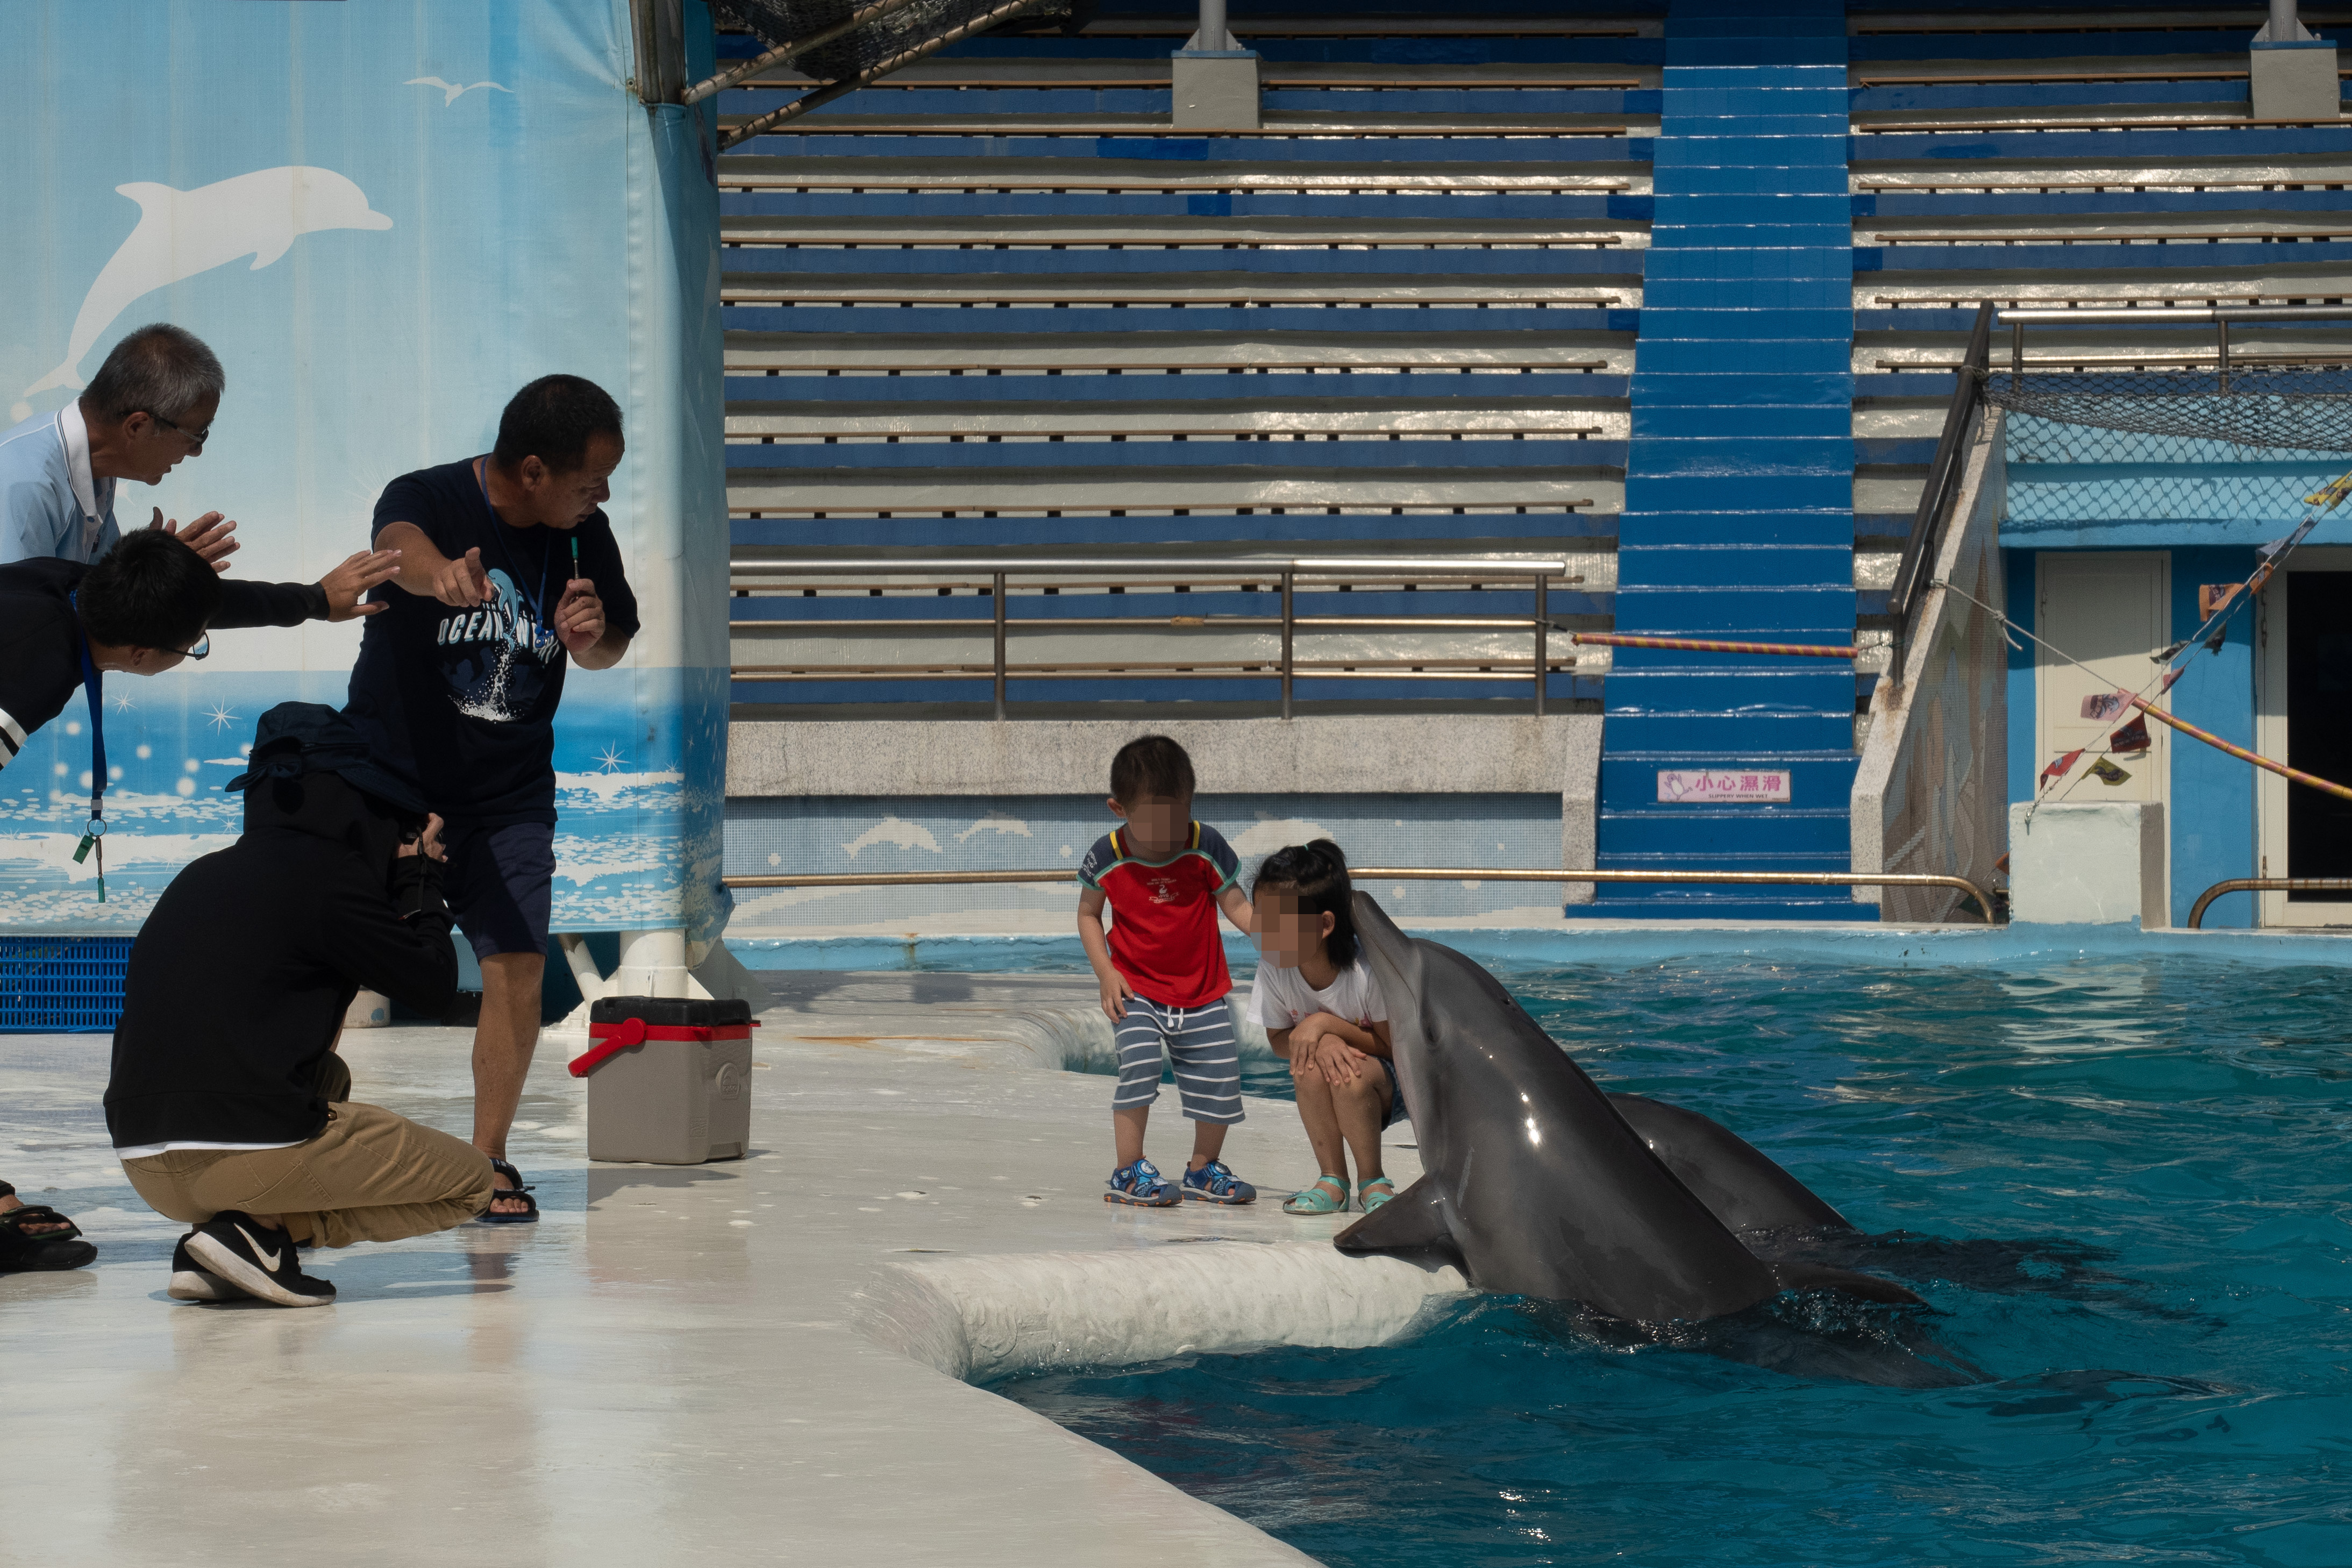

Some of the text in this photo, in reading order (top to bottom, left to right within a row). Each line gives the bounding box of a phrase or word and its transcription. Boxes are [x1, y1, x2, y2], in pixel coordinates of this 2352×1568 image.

[437, 610, 504, 645] OCEAN
[1695, 775, 1781, 792] 小心濕滑
